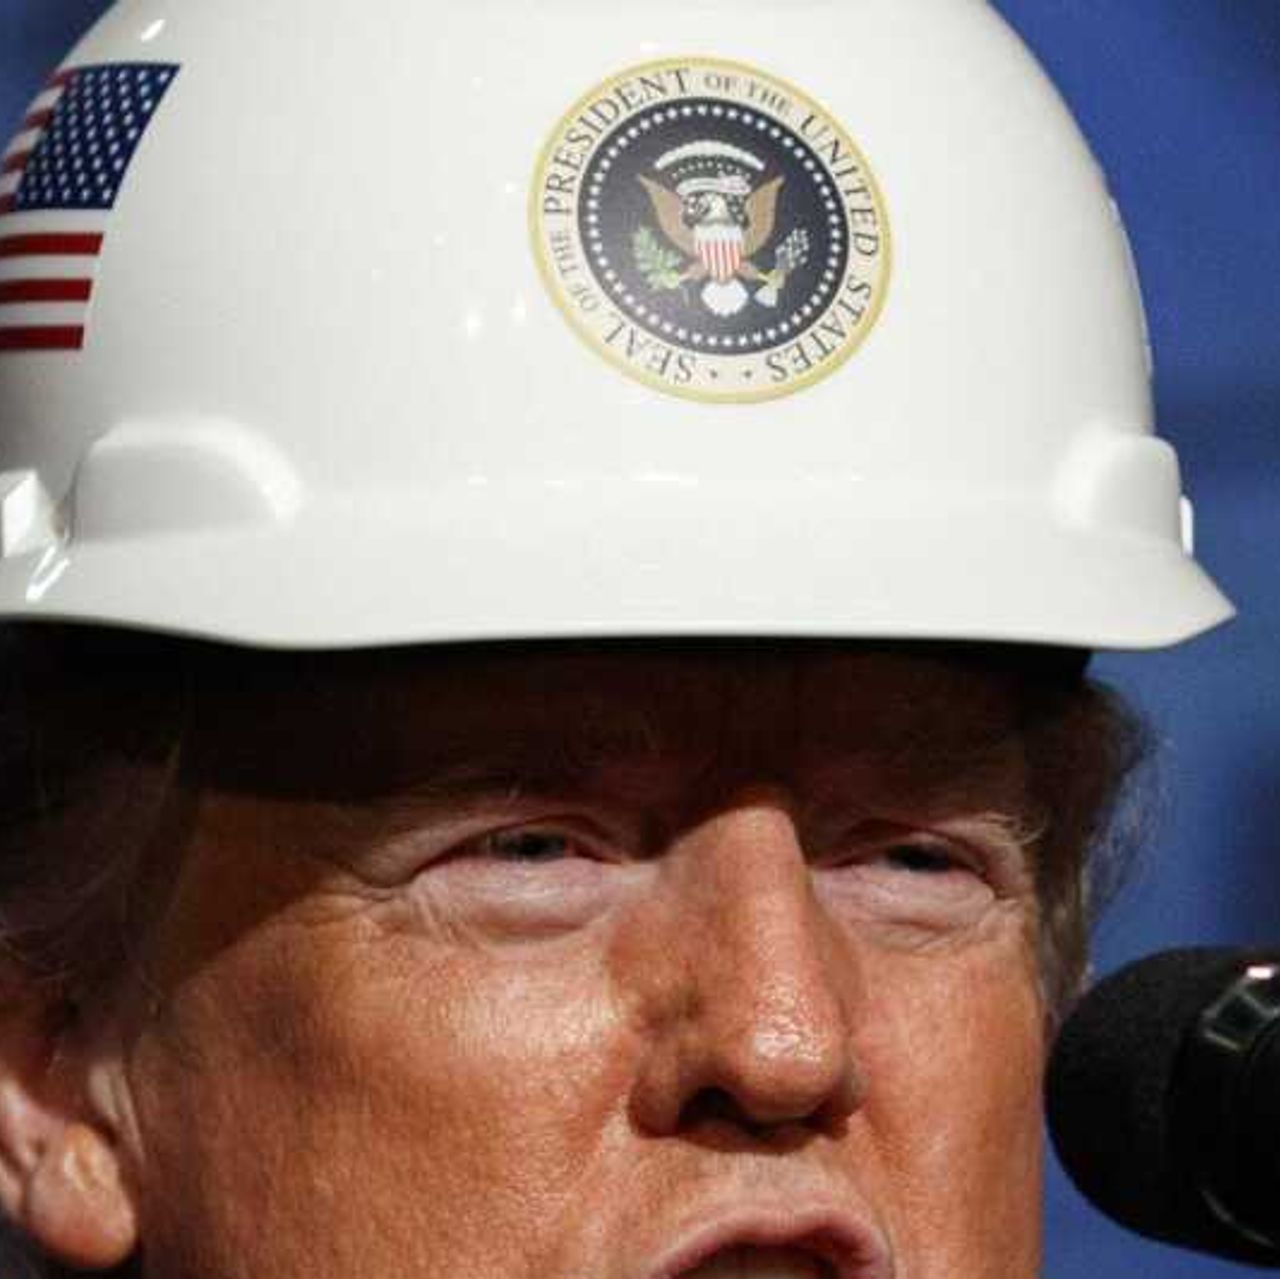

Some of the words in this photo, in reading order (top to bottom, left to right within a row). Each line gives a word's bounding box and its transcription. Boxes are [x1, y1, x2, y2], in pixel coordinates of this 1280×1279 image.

[704, 75, 736, 96] OF
[746, 80, 795, 114] THE
[544, 68, 691, 215] PRESIDENT
[800, 114, 880, 256] UNITED
[550, 233, 577, 278] THE
[567, 282, 596, 312] OF
[603, 319, 698, 384] SEAL
[766, 276, 873, 382] STATES
